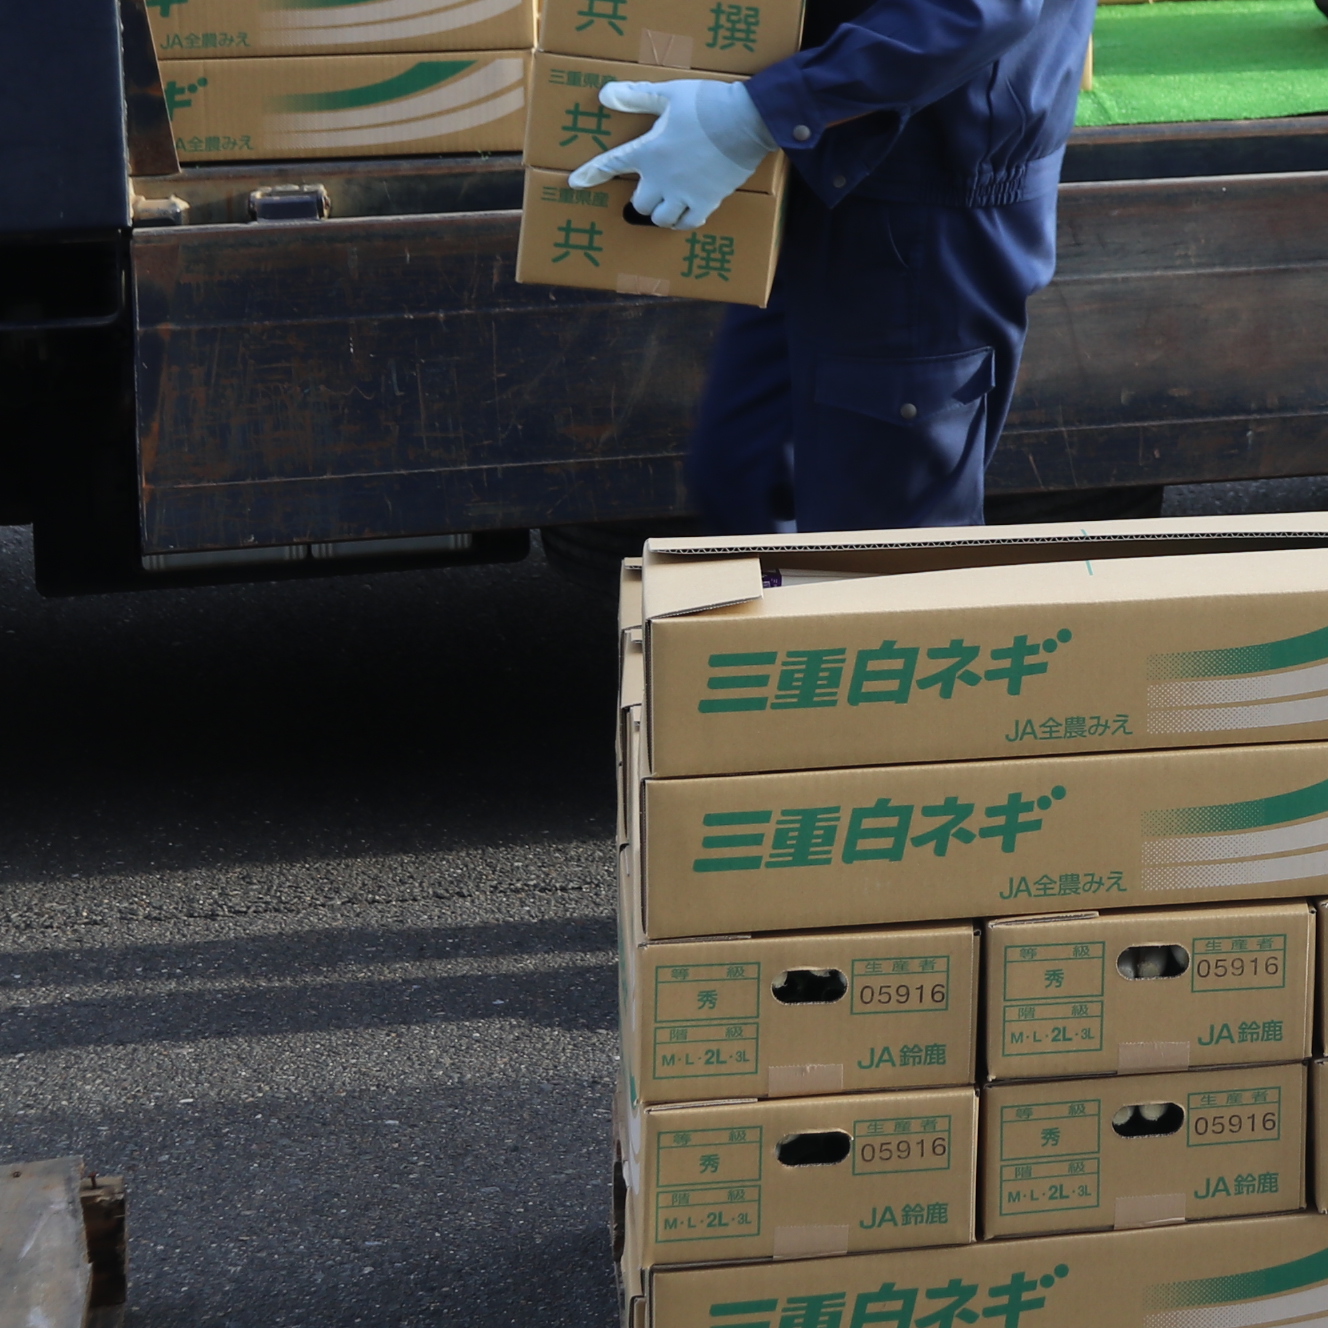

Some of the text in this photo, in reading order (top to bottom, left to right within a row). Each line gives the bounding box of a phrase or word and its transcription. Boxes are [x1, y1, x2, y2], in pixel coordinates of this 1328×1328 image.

[162, 32, 250, 49] JA全農みえ
[706, 3, 760, 52] 撰
[560, 101, 613, 152] 共
[542, 185, 608, 207] 三重県産
[552, 220, 734, 281] 共 撰
[699, 629, 1072, 713] 三重白ネギ
[1006, 714, 1133, 742] JA全農みえ
[694, 786, 1066, 872] 三重白ネギ
[999, 871, 1127, 899] JA全農みえ
[1046, 969, 1063, 987] 秀
[1197, 957, 1278, 978] 05916
[699, 990, 717, 1009] 秀
[860, 984, 945, 1004] 05916
[1198, 1020, 1283, 1046] JA鈴鹿
[858, 1043, 946, 1069] JA鈴鹿
[1195, 1113, 1275, 1135] 05916
[861, 1137, 946, 1162] 05916
[1194, 1172, 1279, 1199] JA鈴鹿
[860, 1202, 948, 1229] JA鈴鹿
